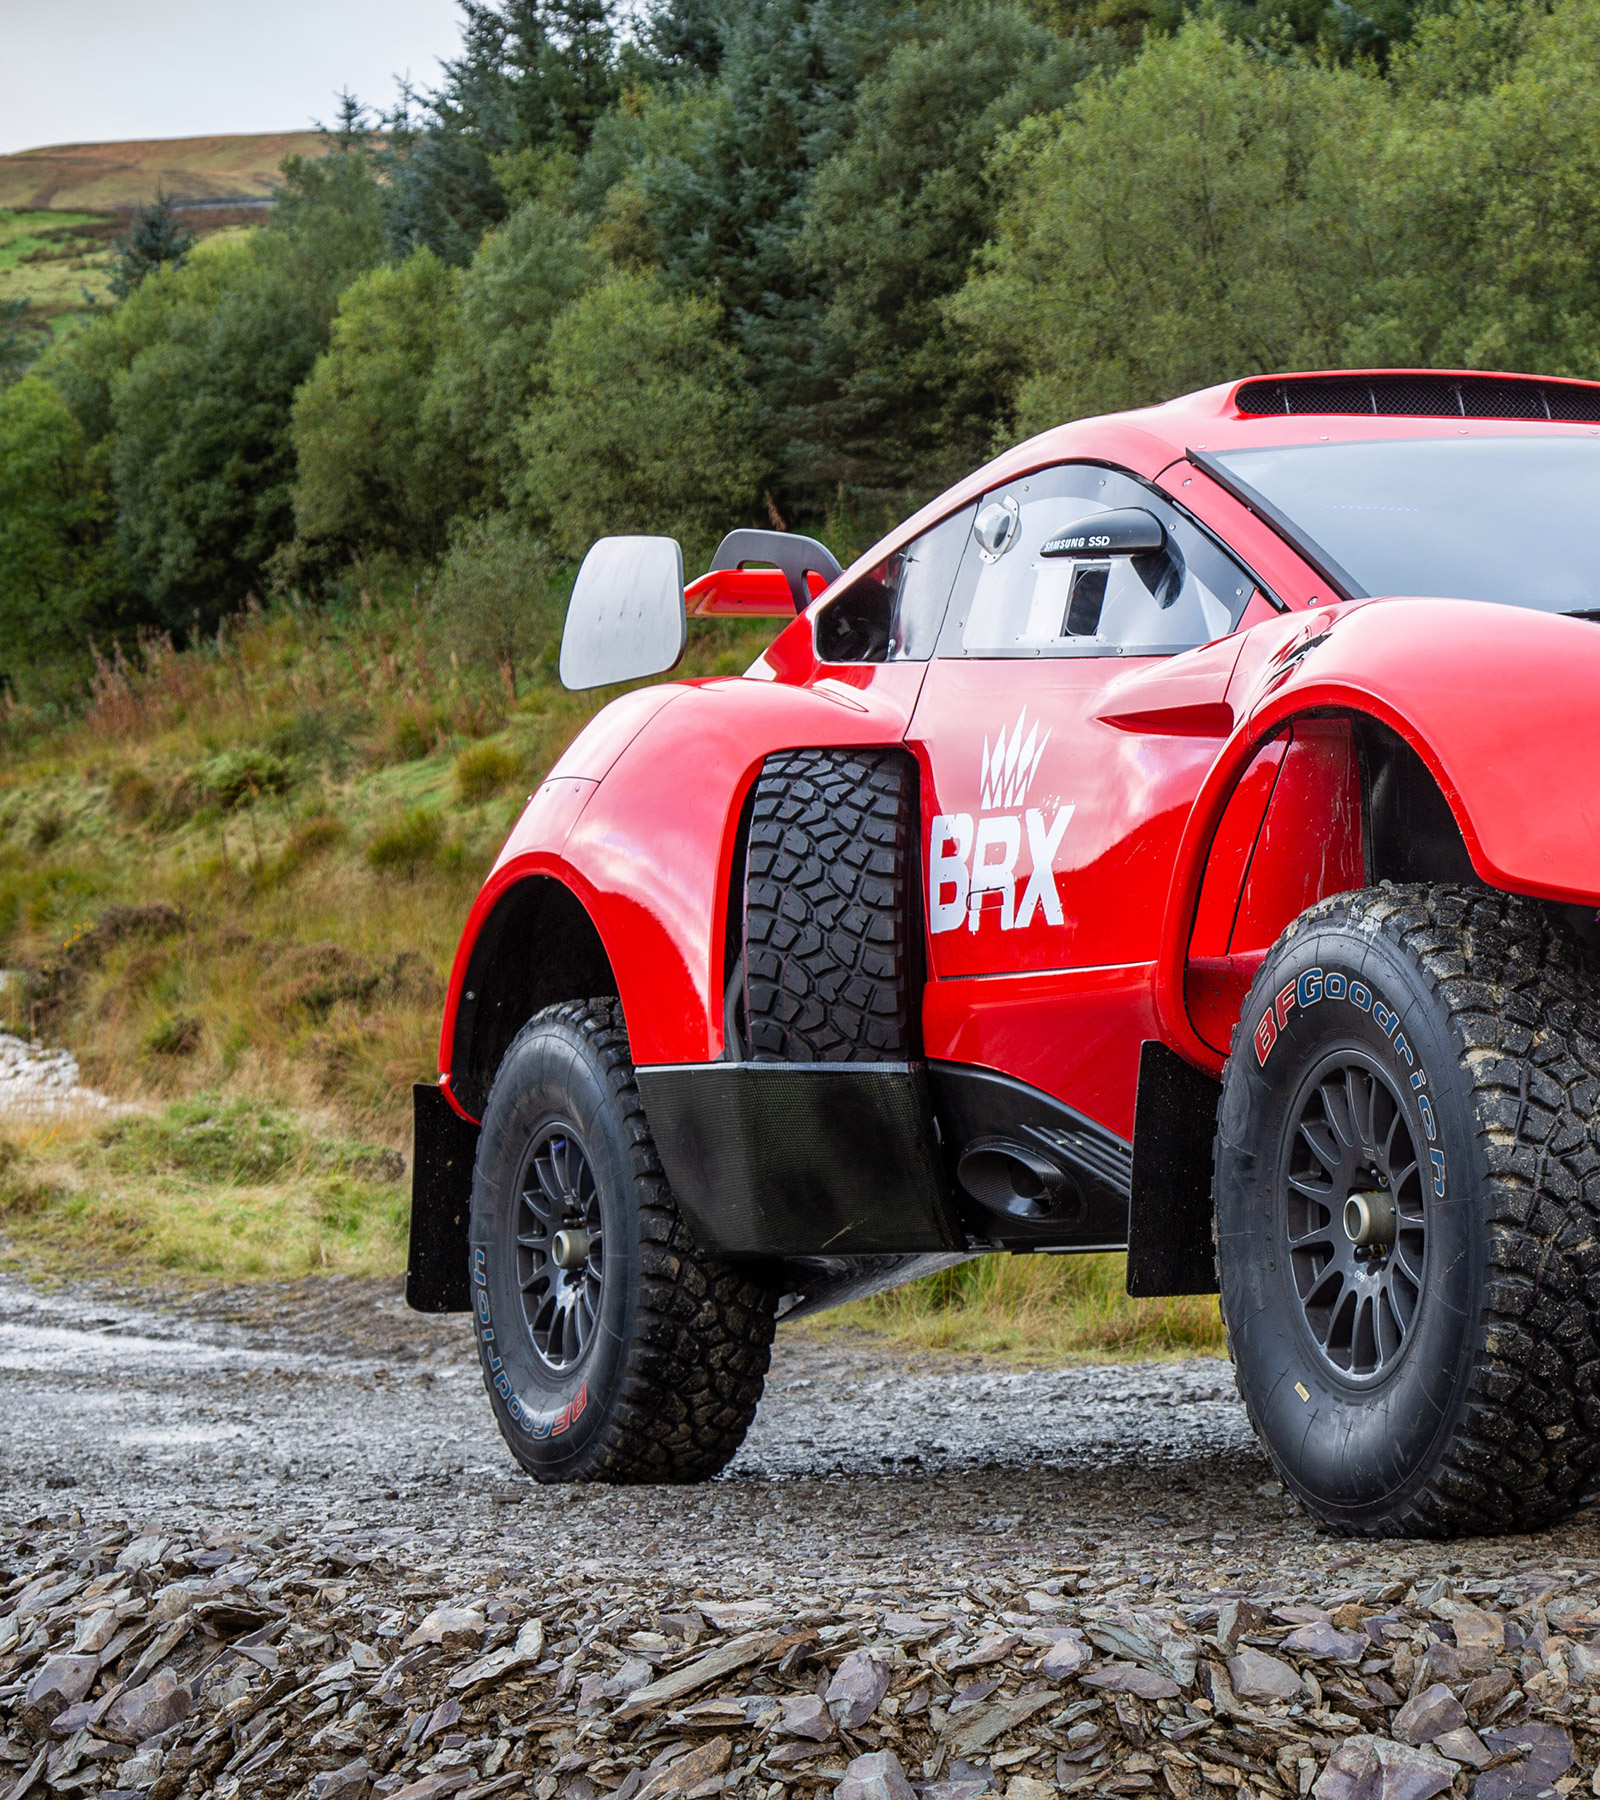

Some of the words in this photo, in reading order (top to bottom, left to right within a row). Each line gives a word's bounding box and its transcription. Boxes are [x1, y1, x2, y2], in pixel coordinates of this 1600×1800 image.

[1043, 537, 1086, 551] SAMSUNG
[1088, 535, 1110, 547] SSD
[930, 804, 1076, 934] BRX
[1254, 967, 1447, 1198] BFGoodrich
[474, 1248, 588, 1440] BFGoodrich
